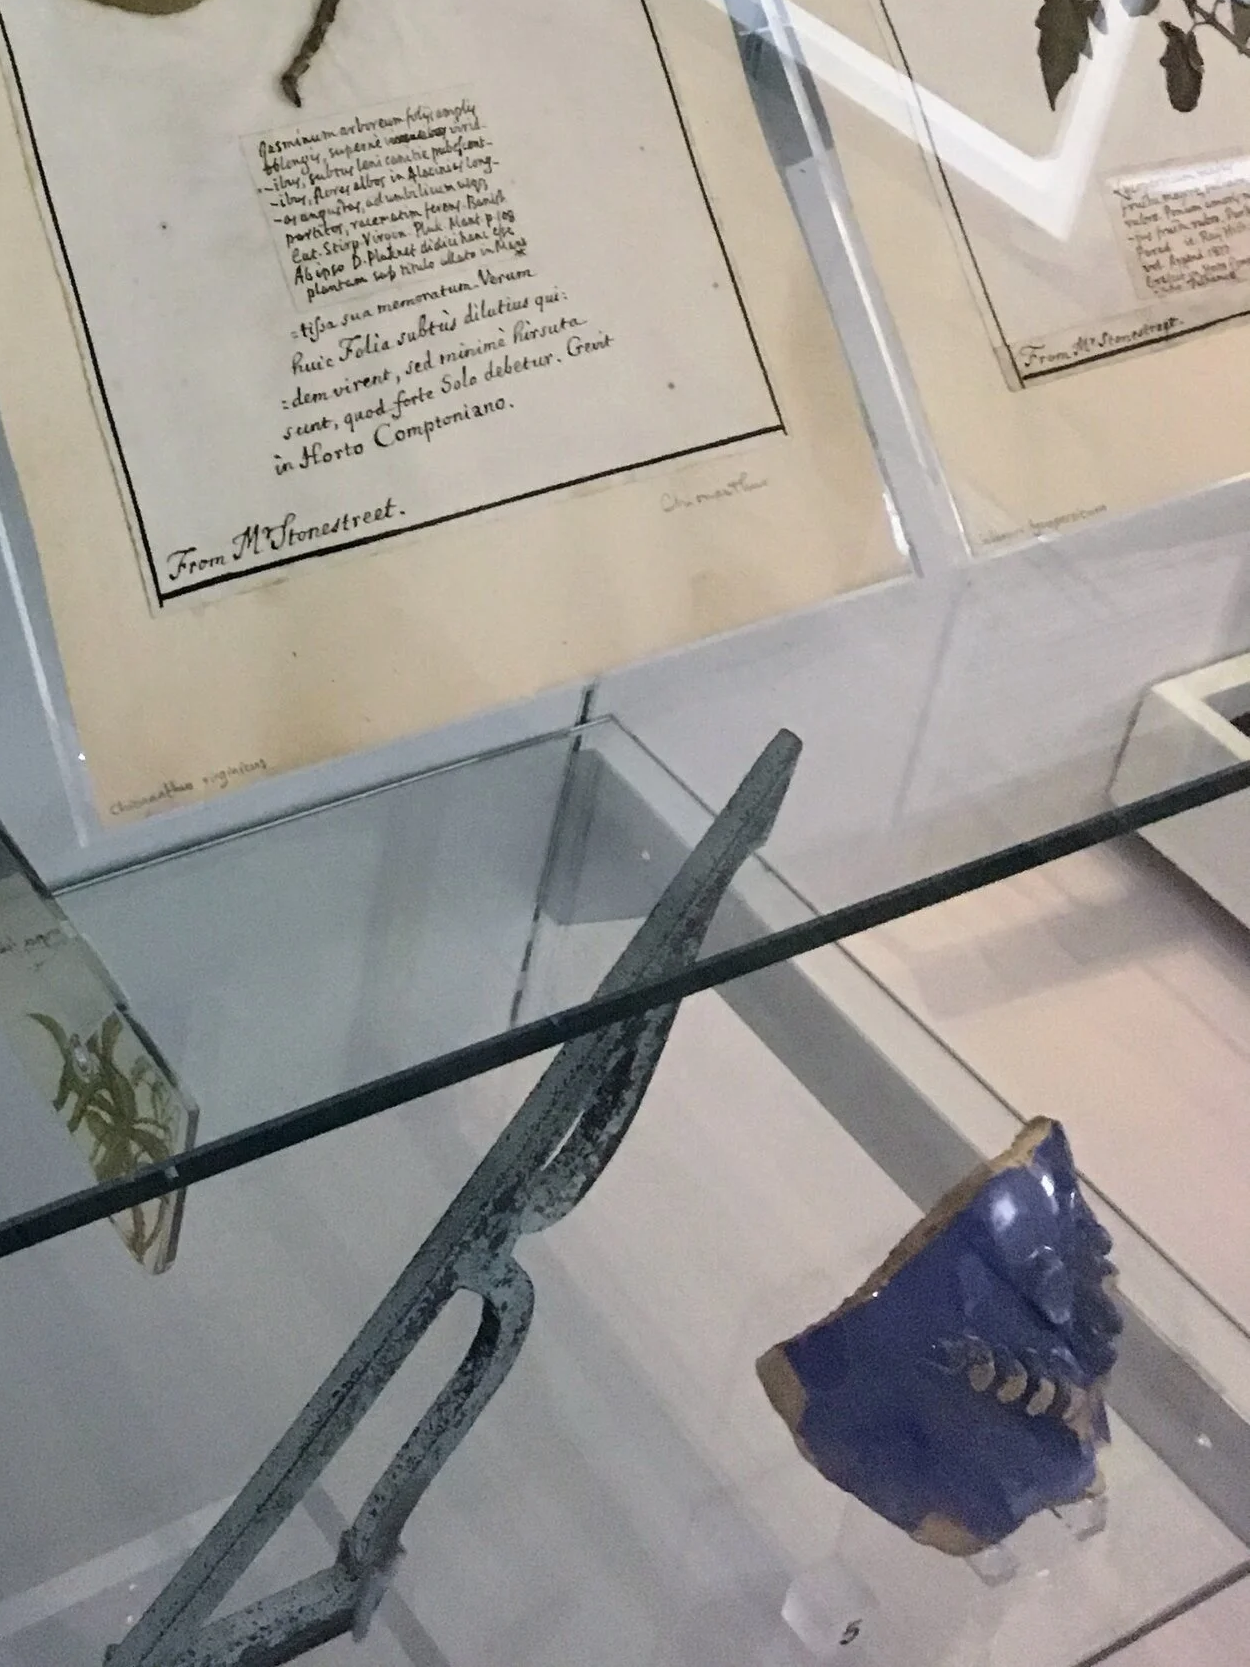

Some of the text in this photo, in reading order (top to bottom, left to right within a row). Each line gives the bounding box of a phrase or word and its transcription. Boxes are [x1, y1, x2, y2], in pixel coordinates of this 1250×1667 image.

[477, 268, 537, 285] Verum
[338, 333, 393, 362] Folia
[1019, 344, 1071, 367] From
[405, 349, 435, 375] sed
[344, 398, 387, 432] quod
[273, 454, 294, 475] in
[166, 546, 226, 581] From
[839, 1618, 863, 1646] 5
